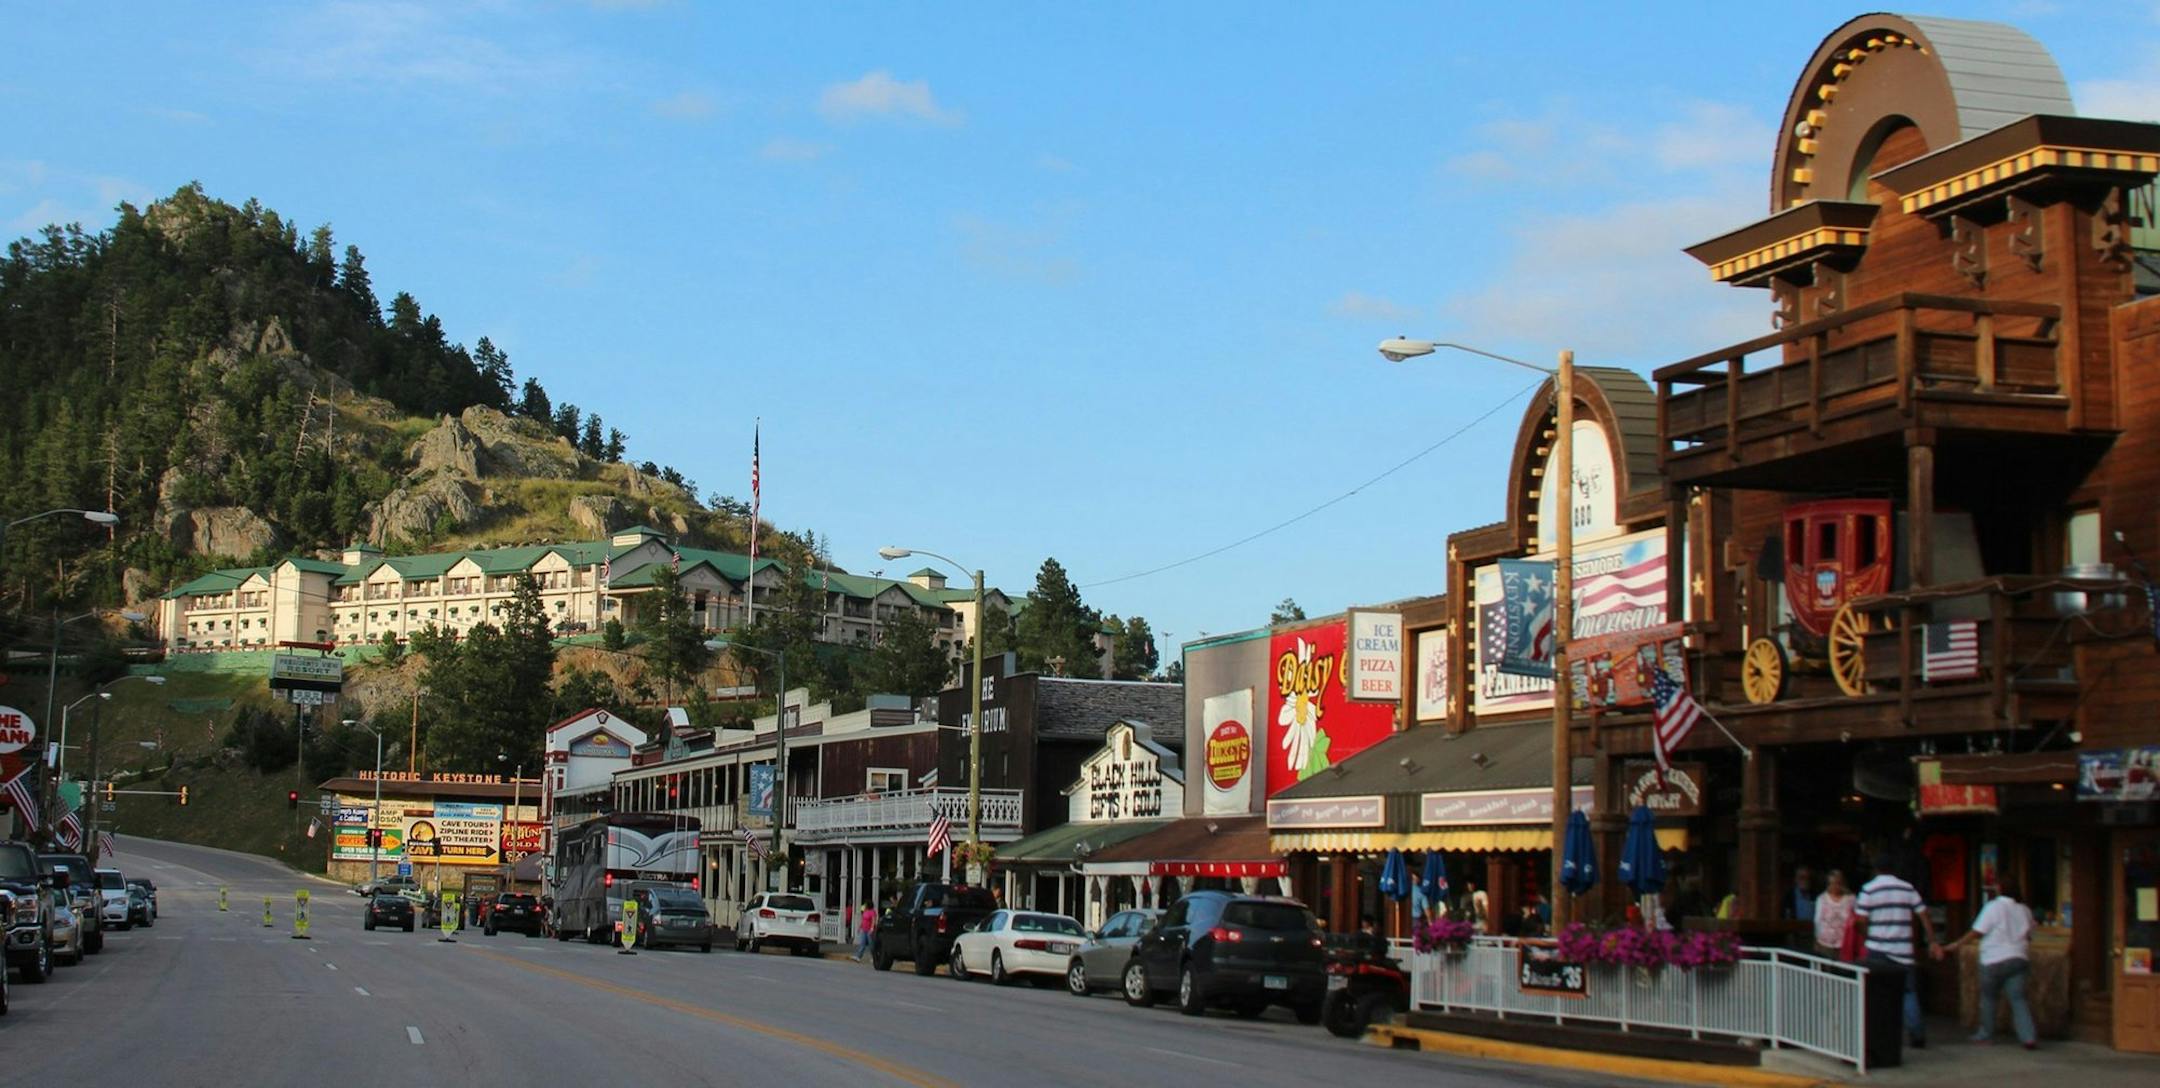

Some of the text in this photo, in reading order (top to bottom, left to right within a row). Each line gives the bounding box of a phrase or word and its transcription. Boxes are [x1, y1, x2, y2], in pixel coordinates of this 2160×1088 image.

[1373, 624, 1394, 638] ICE
[1356, 638, 1400, 651] CREAM
[1360, 658, 1396, 672] PIZZA
[982, 675, 995, 701] HE
[1277, 643, 1333, 720] Daisy
[1361, 679, 1393, 692] BEER
[0, 714, 21, 728] HE
[961, 706, 1007, 737] EMRIUM
[359, 770, 502, 785] HISTORIC KEYSTONE
[1091, 760, 1162, 791] BLACK HILLS
[1090, 791, 1120, 819] GIFTS
[1133, 788, 1162, 817] GOLD
[441, 820, 461, 828] CAVE
[442, 846, 487, 855] TURN HERE
